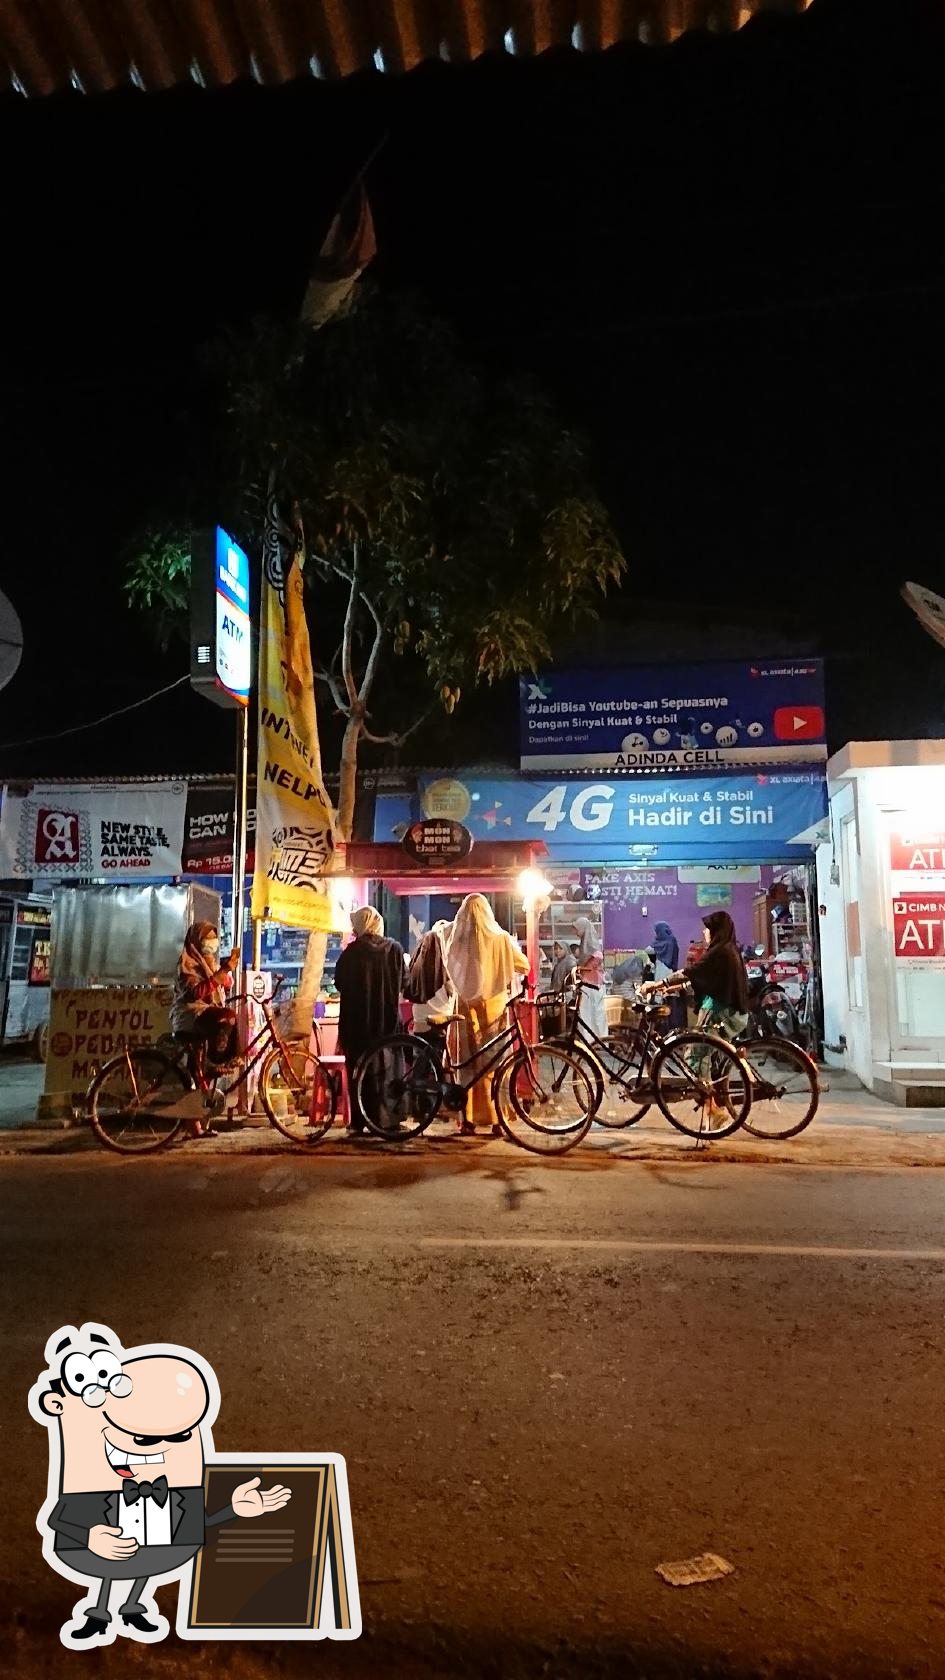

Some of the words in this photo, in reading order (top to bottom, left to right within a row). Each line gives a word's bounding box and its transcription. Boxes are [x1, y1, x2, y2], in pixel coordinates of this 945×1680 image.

[528, 703, 586, 714] #JadiBisa
[589, 699, 658, 712] Youtube-an
[661, 696, 728, 711] Sepuasnya
[528, 719, 570, 730] Dengan
[572, 717, 605, 730] Sinyal
[607, 715, 633, 726] Kuat
[635, 715, 643, 726] &
[646, 713, 678, 725] Stabil
[615, 752, 678, 766] ADINDA
[683, 750, 725, 764] CELL
[629, 792, 667, 806] Sinyal
[670, 791, 699, 802] Kuat
[703, 791, 713, 802] &
[716, 790, 754, 801] Stabil
[526, 784, 616, 831] 4G
[189, 813, 229, 827] HOW
[628, 806, 693, 826] Hadir
[699, 806, 721, 825] di
[729, 806, 773, 825] Sini
[101, 820, 131, 834] NEW
[189, 825, 227, 839] CAN
[424, 827, 451, 836] MON
[101, 832, 136, 845] SAME
[424, 836, 451, 844] MON
[101, 844, 153, 857] ALWAYS.
[101, 859, 118, 869] GO
[120, 858, 151, 868] AHEAD
[187, 859, 203, 868] Rp
[909, 849, 945, 869] AT
[585, 872, 619, 884] PAKE
[624, 872, 656, 883] AXIS
[625, 884, 678, 896] HEMAT!
[908, 902, 937, 912] CIMB
[898, 919, 945, 950] AT
[75, 1008, 154, 1031] PENTOL
